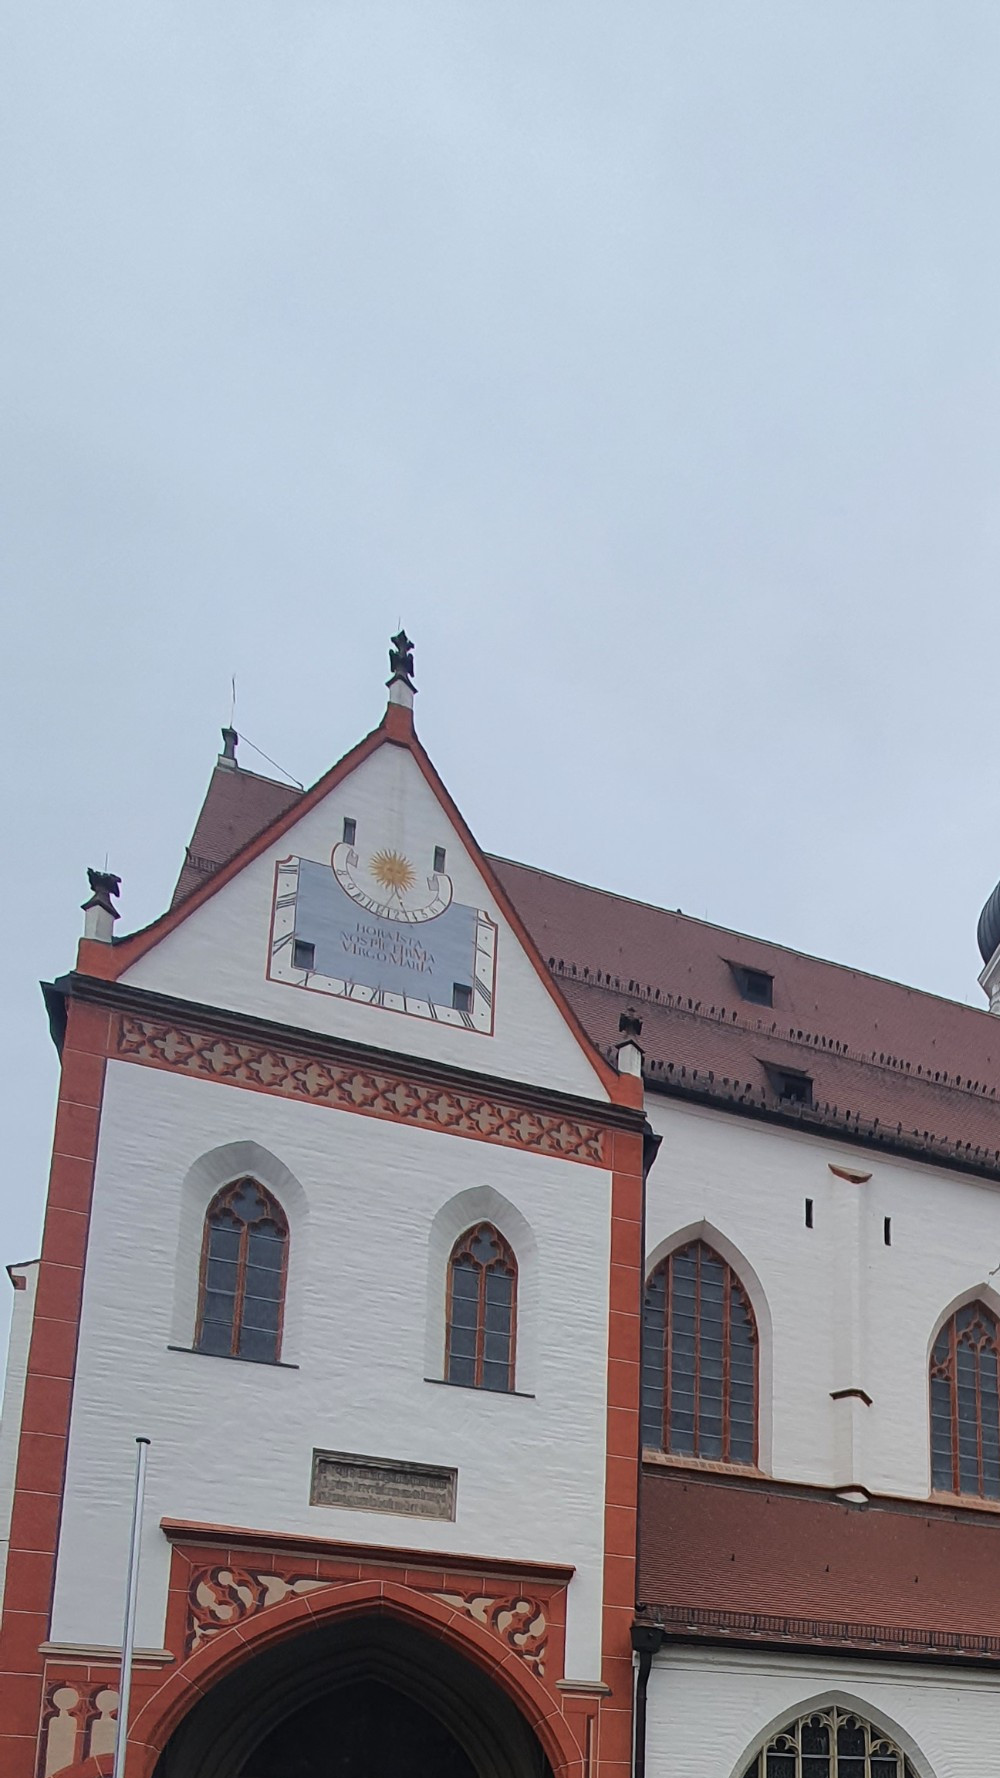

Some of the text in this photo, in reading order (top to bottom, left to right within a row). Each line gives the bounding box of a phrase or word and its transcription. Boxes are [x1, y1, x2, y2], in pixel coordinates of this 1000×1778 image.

[341, 931, 367, 946] NOS
[356, 922, 423, 949] HORA ISTA
[342, 941, 433, 975] VIRGO MARIA
